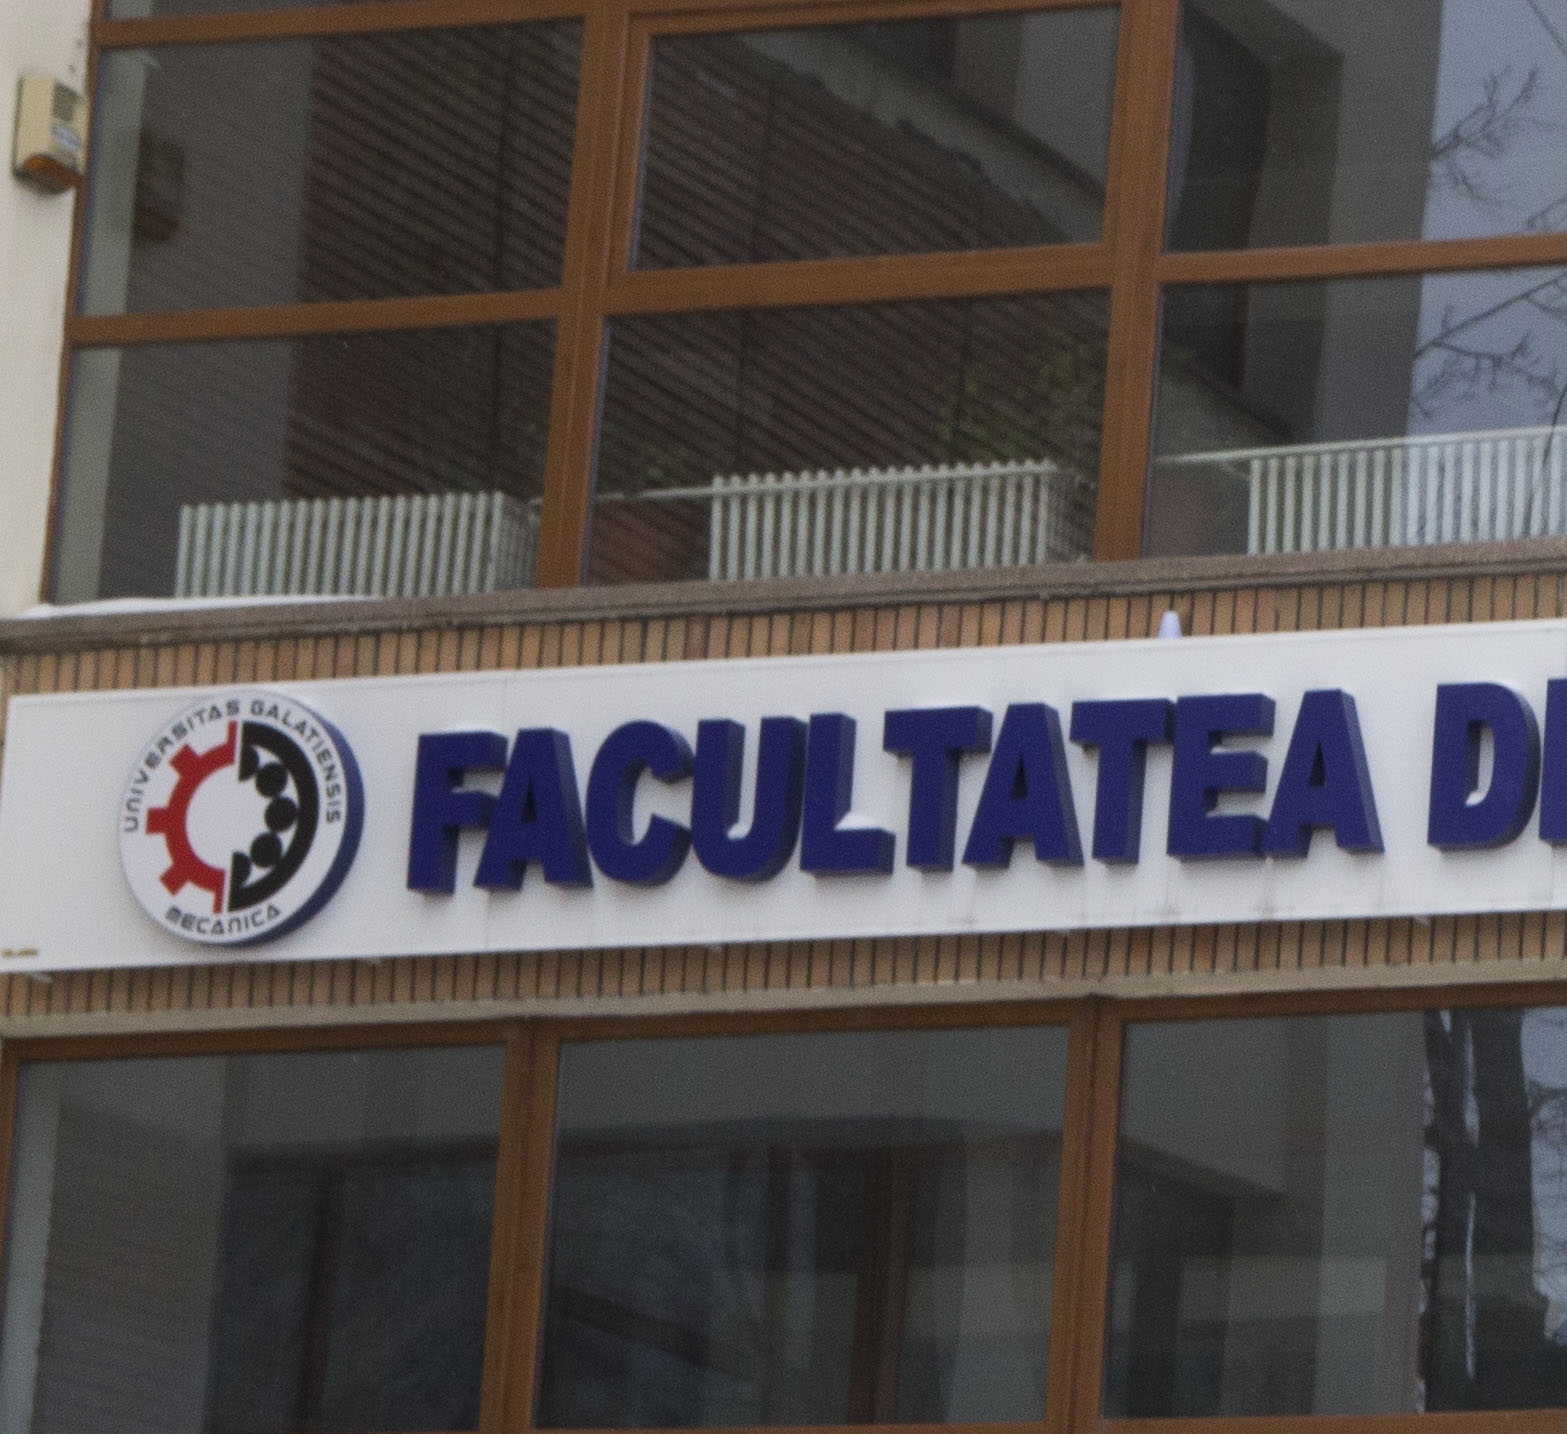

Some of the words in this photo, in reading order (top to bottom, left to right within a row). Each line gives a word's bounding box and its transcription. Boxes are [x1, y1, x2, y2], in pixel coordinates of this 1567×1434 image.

[124, 700, 240, 833] UNIVERSITAS
[250, 700, 341, 824] GALATIENSIS
[406, 688, 1384, 894] FACULTATEA
[164, 904, 281, 935] MECANICA
